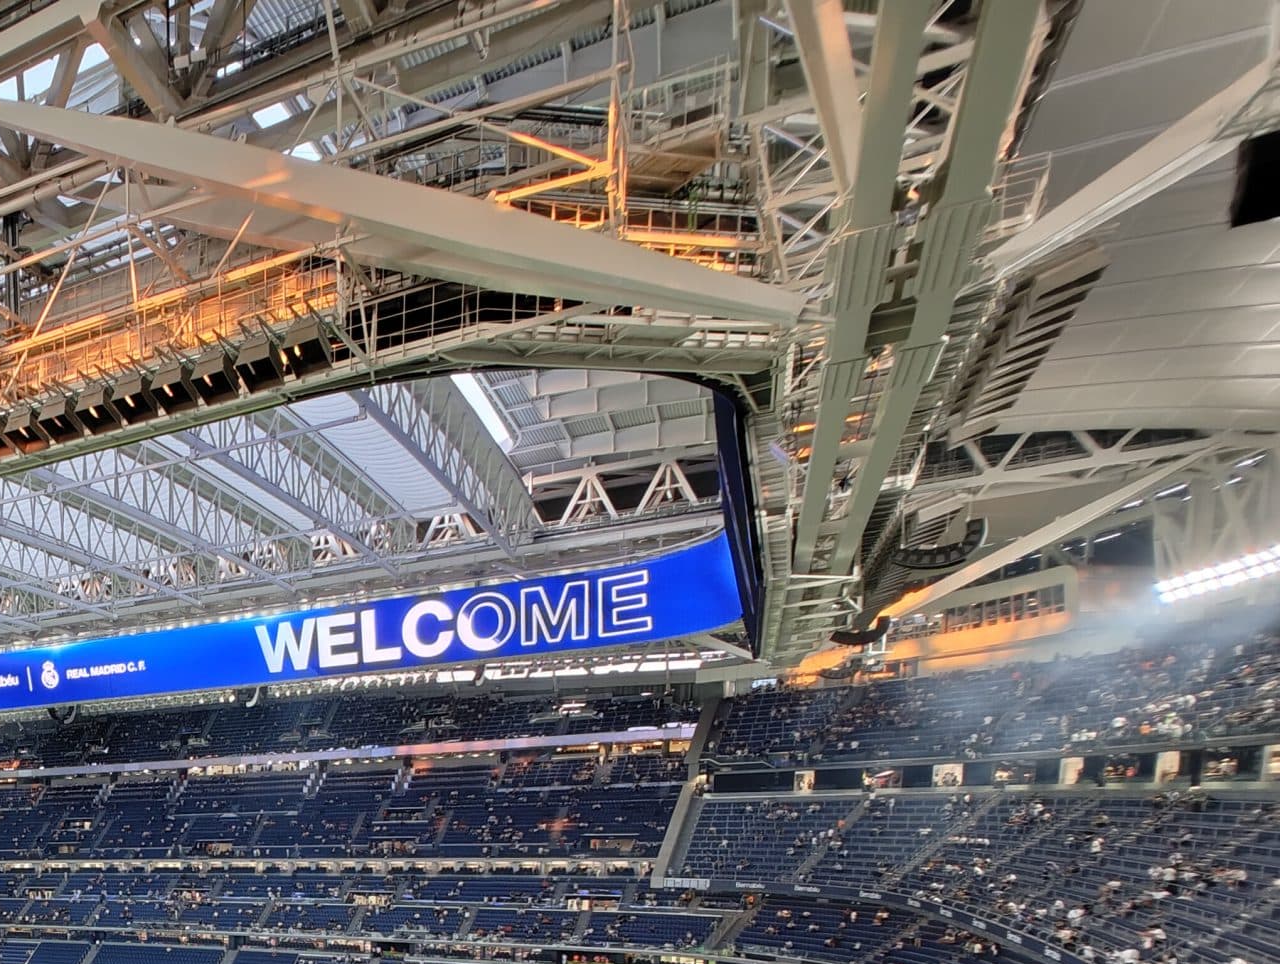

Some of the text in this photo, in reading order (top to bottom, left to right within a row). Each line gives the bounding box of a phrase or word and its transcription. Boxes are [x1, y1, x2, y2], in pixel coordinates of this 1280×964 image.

[255, 569, 654, 674] WELCOME
[66, 668, 90, 680] REAL
[90, 664, 126, 678] MADRID
